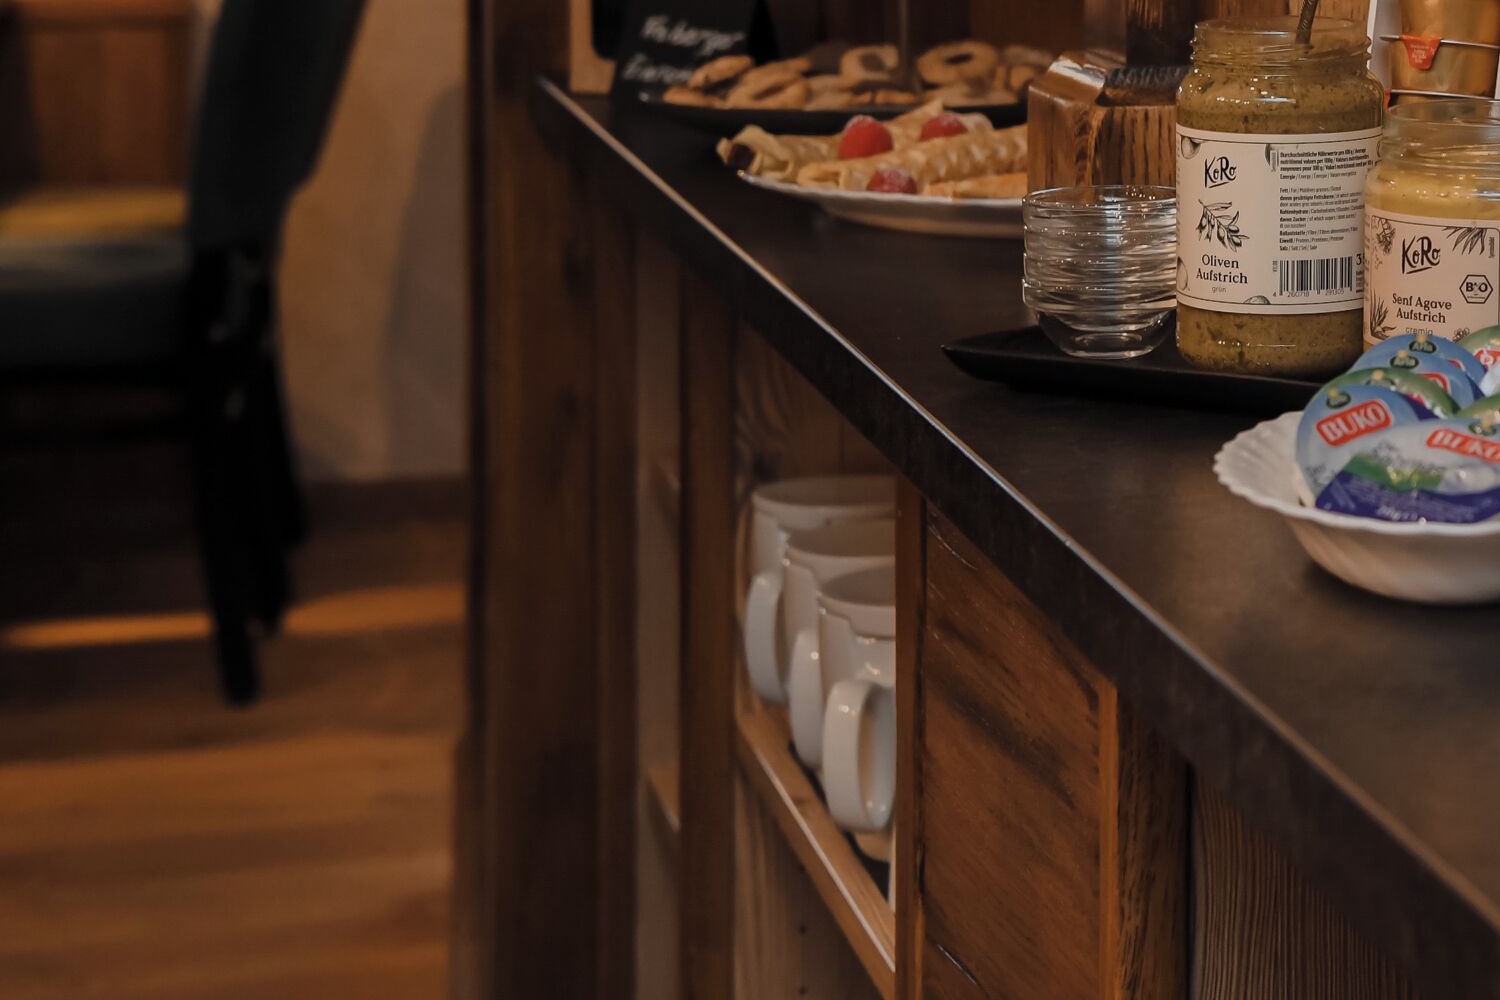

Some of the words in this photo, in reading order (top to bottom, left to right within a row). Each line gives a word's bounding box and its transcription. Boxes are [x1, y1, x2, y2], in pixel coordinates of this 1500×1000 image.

[1204, 156, 1237, 188] KoRo
[1202, 254, 1239, 269] Oliven
[1402, 236, 1441, 274] KoRo
[1196, 268, 1248, 284] Aufstrich
[1212, 286, 1227, 294] grün
[1392, 293, 1412, 307] Senf
[1415, 297, 1452, 311] Agave
[1397, 308, 1446, 323] Aufstrich
[1413, 342, 1434, 353] Arla
[1395, 357, 1416, 368] Arla
[1322, 404, 1386, 442] BUKO
